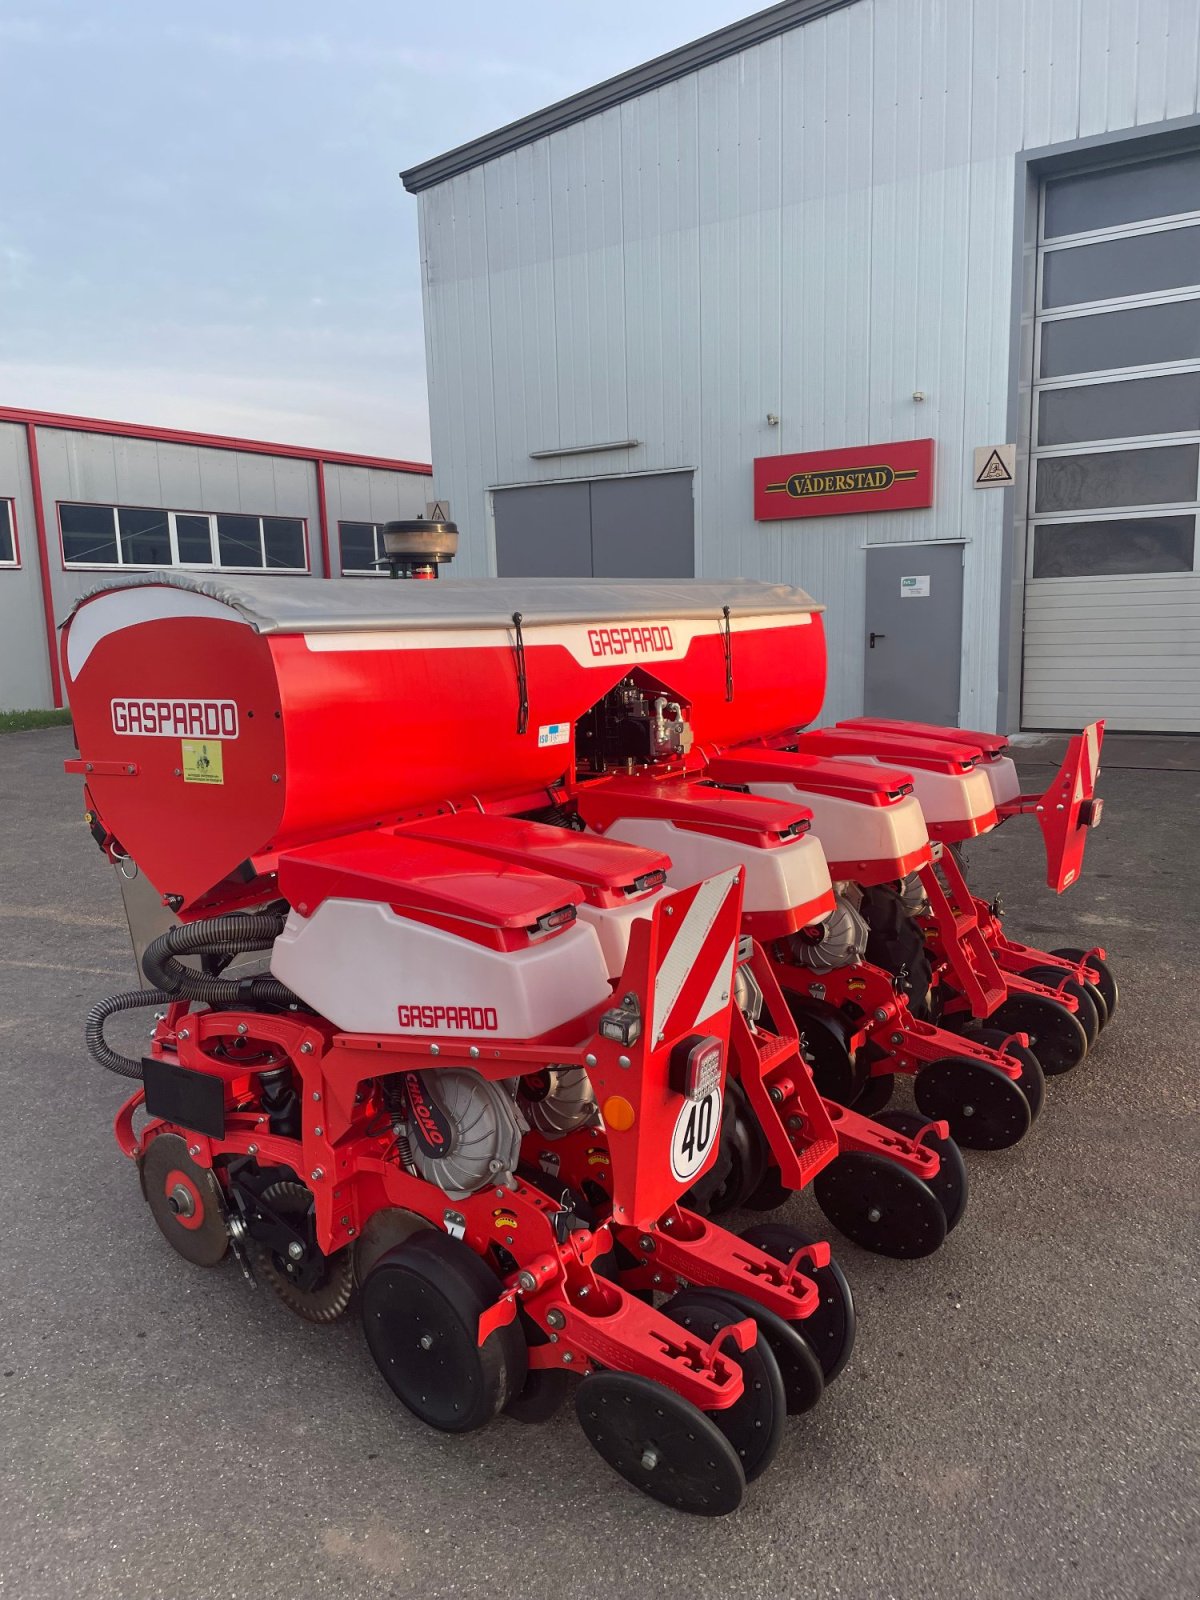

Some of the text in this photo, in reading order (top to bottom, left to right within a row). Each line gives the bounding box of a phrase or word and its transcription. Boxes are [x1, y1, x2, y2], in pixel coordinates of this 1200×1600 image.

[794, 471, 886, 494] VÄDERSTAD
[588, 626, 673, 656] GASPARDO
[113, 702, 237, 736] GASPARDO
[398, 1005, 498, 1031] GASPARDO
[407, 1073, 444, 1145] CHRONO
[681, 1094, 713, 1162] 40
